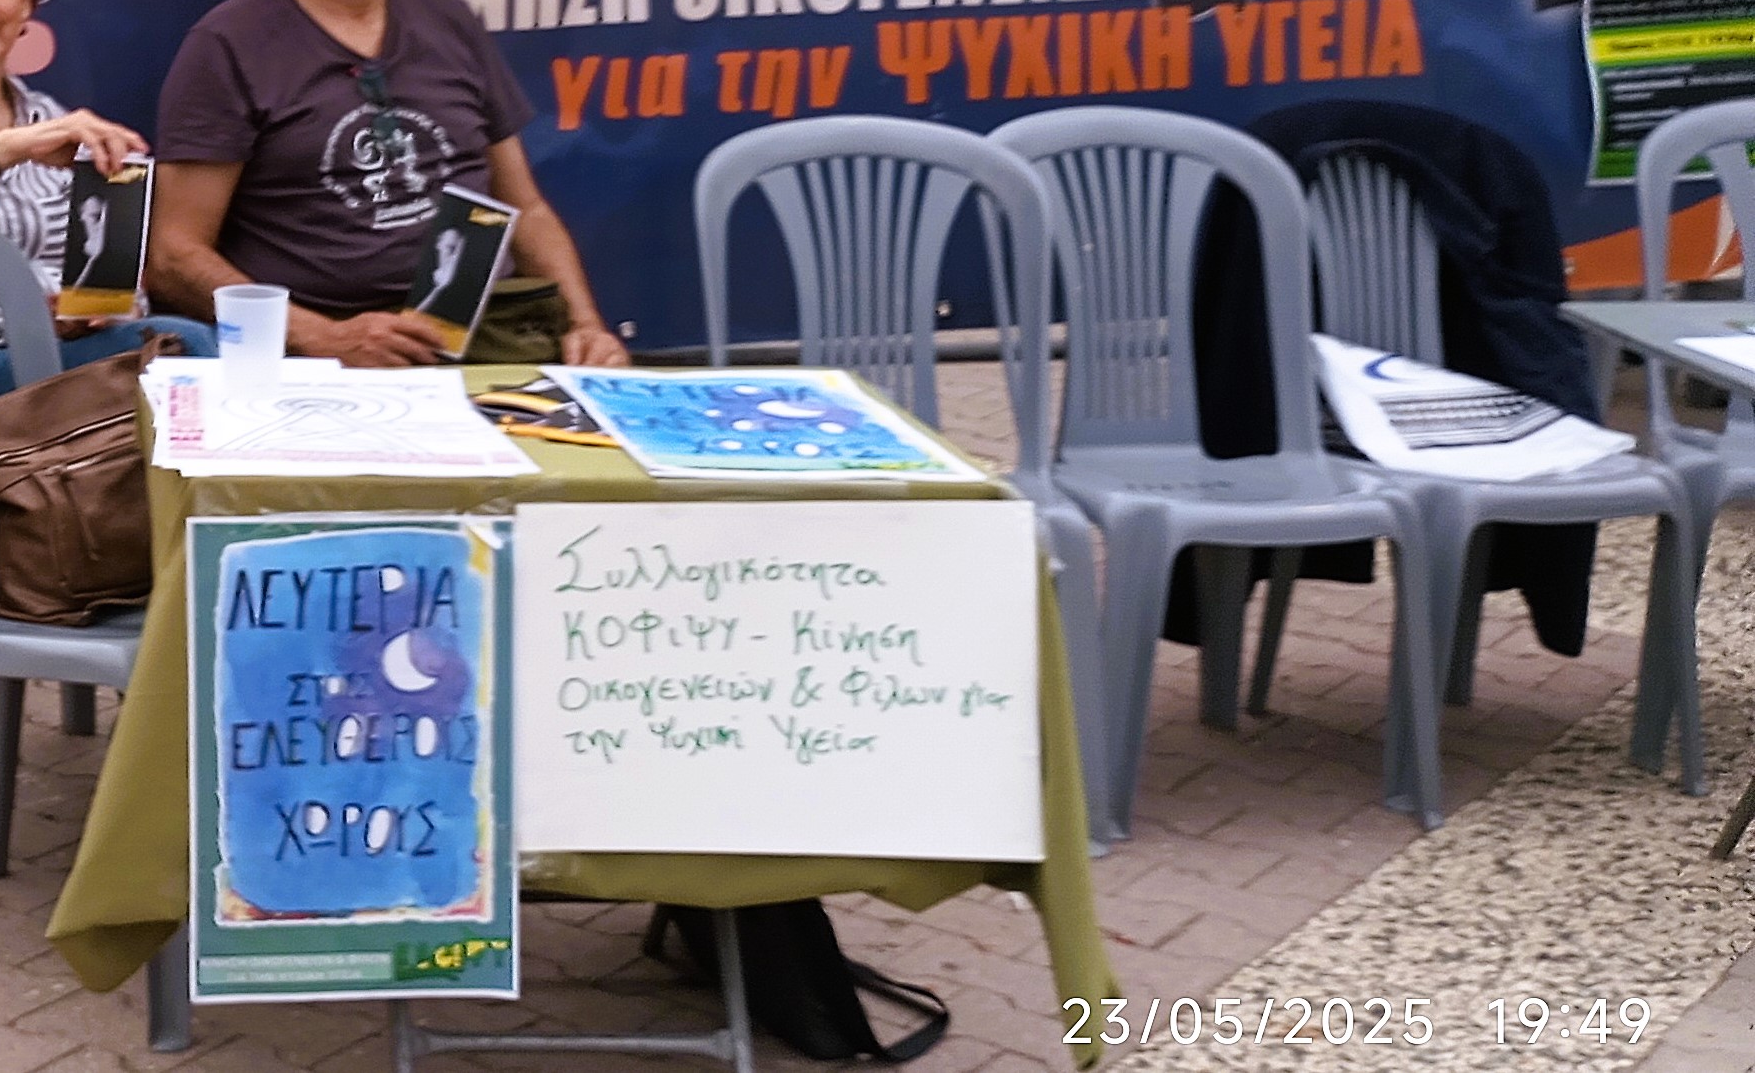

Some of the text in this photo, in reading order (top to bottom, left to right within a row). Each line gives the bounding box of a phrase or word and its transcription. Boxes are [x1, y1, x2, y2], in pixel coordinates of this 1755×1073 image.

[550, 52, 689, 130] για
[716, 45, 852, 118] την
[877, 4, 1193, 105] ΨΥΧΙΚΗ
[554, 525, 887, 602] Συλλογικότητα
[227, 565, 459, 632] ΛΕΥΤΕΡΙΑ
[230, 713, 477, 772] ΕΛΕΥΘΕΡΟΥΣ
[275, 800, 442, 861] ΧΩΡΟΥΣ
